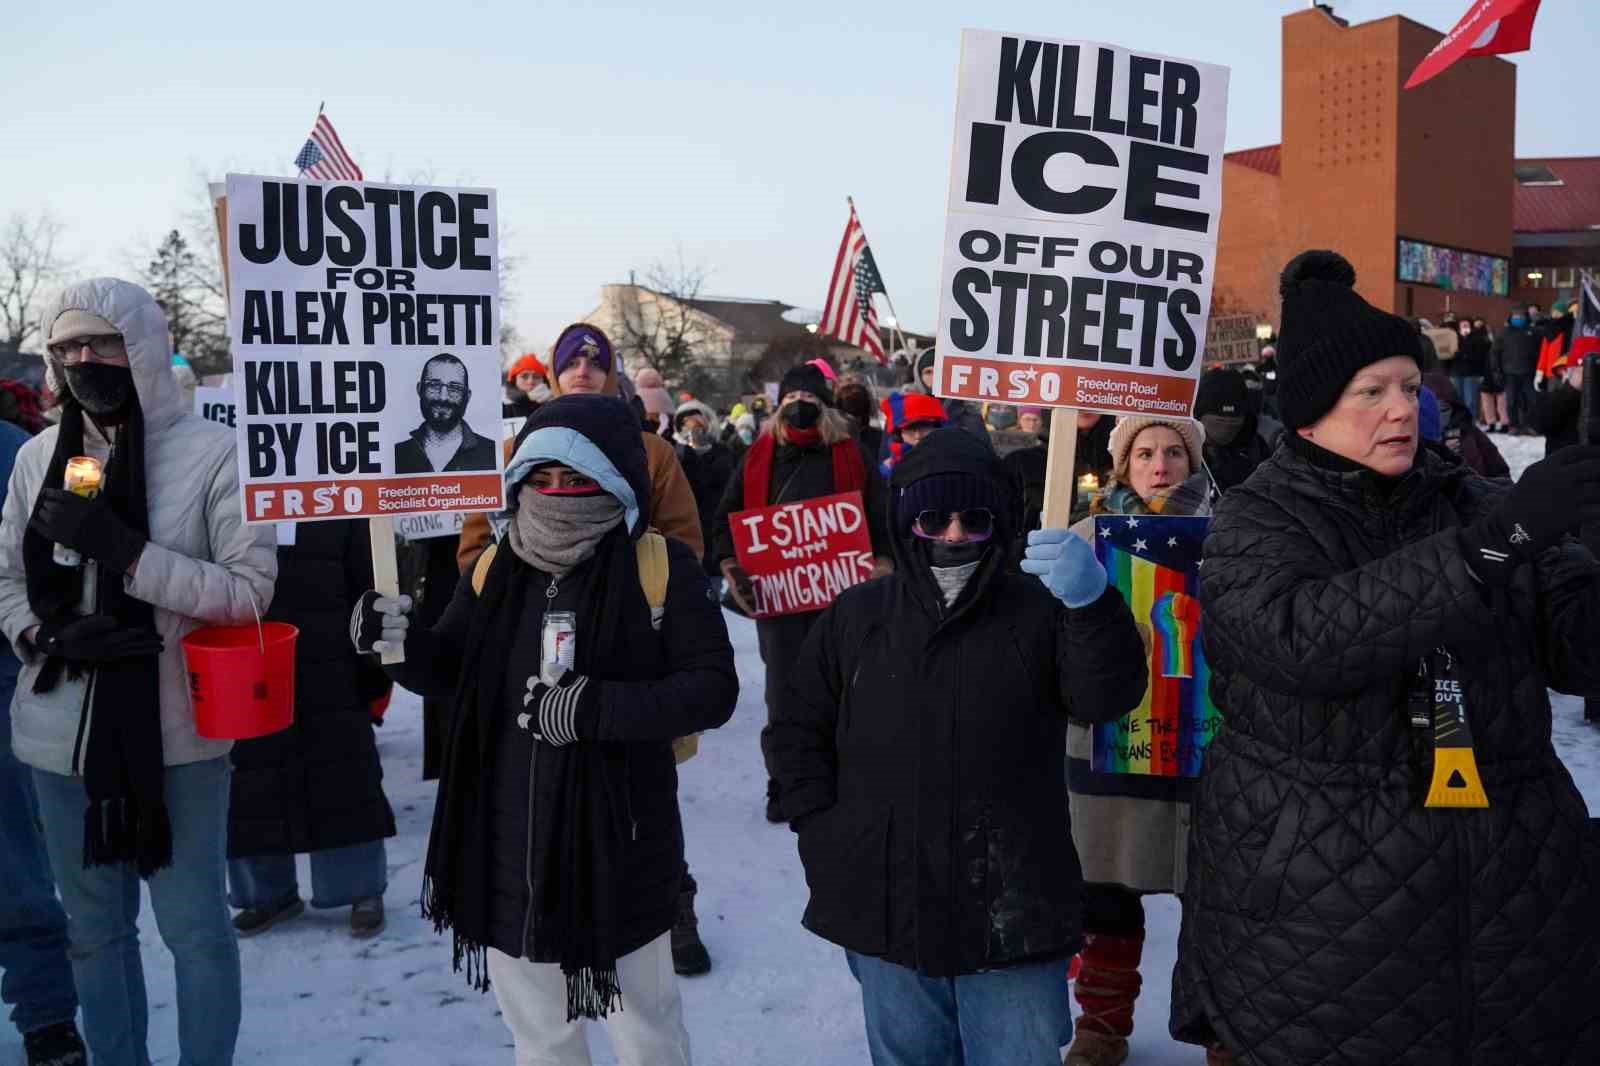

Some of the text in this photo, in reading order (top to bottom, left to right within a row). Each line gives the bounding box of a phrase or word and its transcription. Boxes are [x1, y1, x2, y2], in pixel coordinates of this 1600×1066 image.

[995, 37, 1201, 148] KILLER
[966, 122, 1209, 233] ICE
[239, 181, 492, 270] JUSTICE
[959, 230, 1204, 284] OFF OUR
[327, 268, 415, 291] FOR
[242, 290, 492, 345] ALEX PRETTI
[950, 267, 1201, 371] STREETS
[245, 361, 386, 415] KILLED
[1076, 390, 1187, 412] Socialist Organization
[1077, 376, 1158, 395] Freedom Road
[203, 403, 236, 428] ICE
[248, 422, 381, 477] BY ICE
[378, 483, 461, 498] Freedom Road
[378, 495, 498, 510] Socialist Organization
[400, 513, 442, 535] GOING
[742, 502, 862, 553] I STAND
[782, 538, 828, 559] WITH
[749, 550, 873, 614] IMMIGRANTS
[1434, 679, 1462, 692] ICE
[1119, 715, 1140, 733] WE
[1145, 717, 1175, 736] THE
